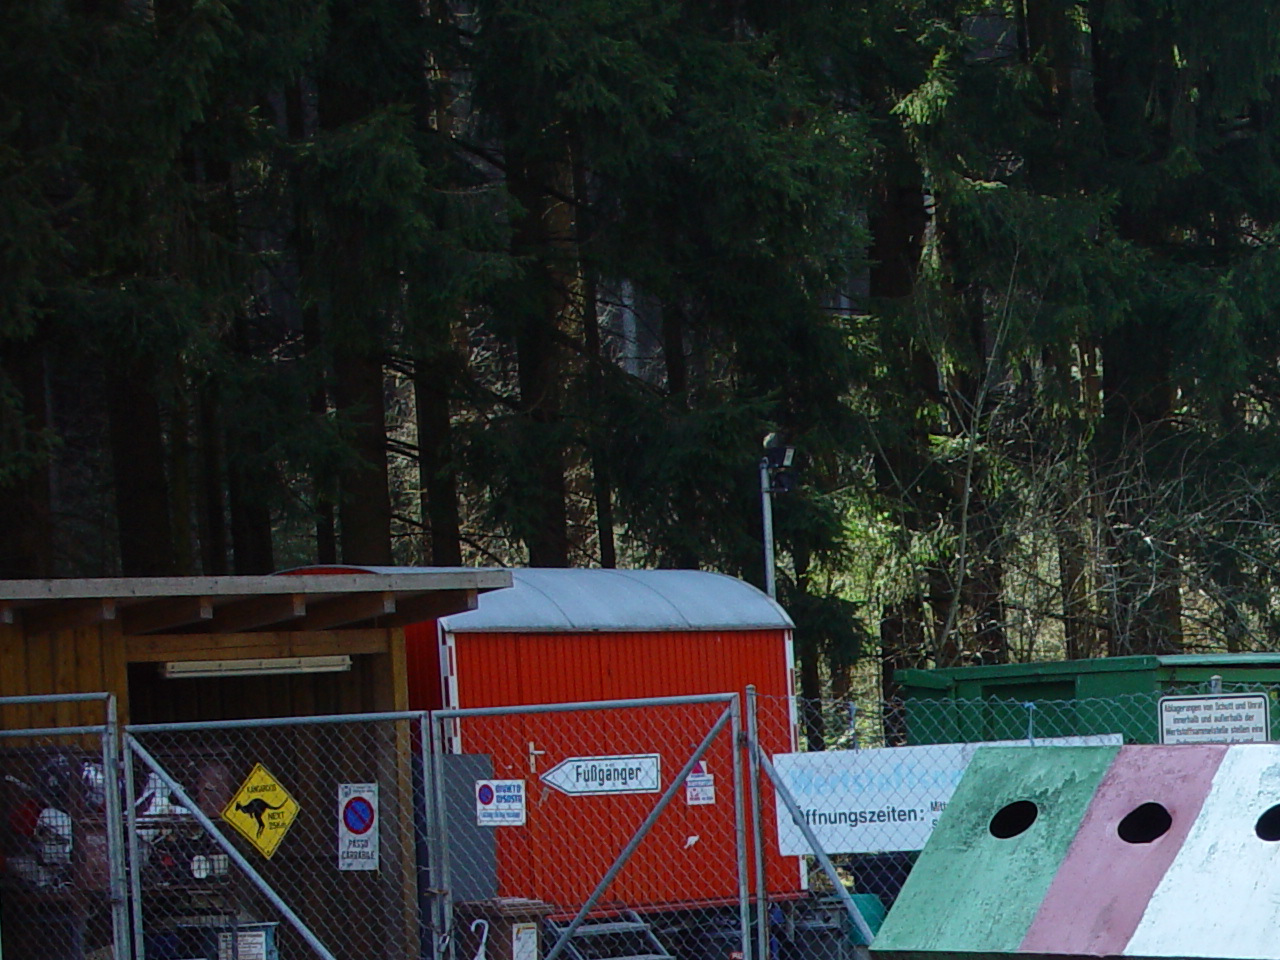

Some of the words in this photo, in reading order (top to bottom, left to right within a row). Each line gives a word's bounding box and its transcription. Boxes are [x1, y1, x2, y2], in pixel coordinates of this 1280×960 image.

[1235, 702, 1246, 710] und
[1201, 714, 1212, 723] und
[1244, 713, 1255, 721] der
[575, 763, 642, 786] Fußgänger
